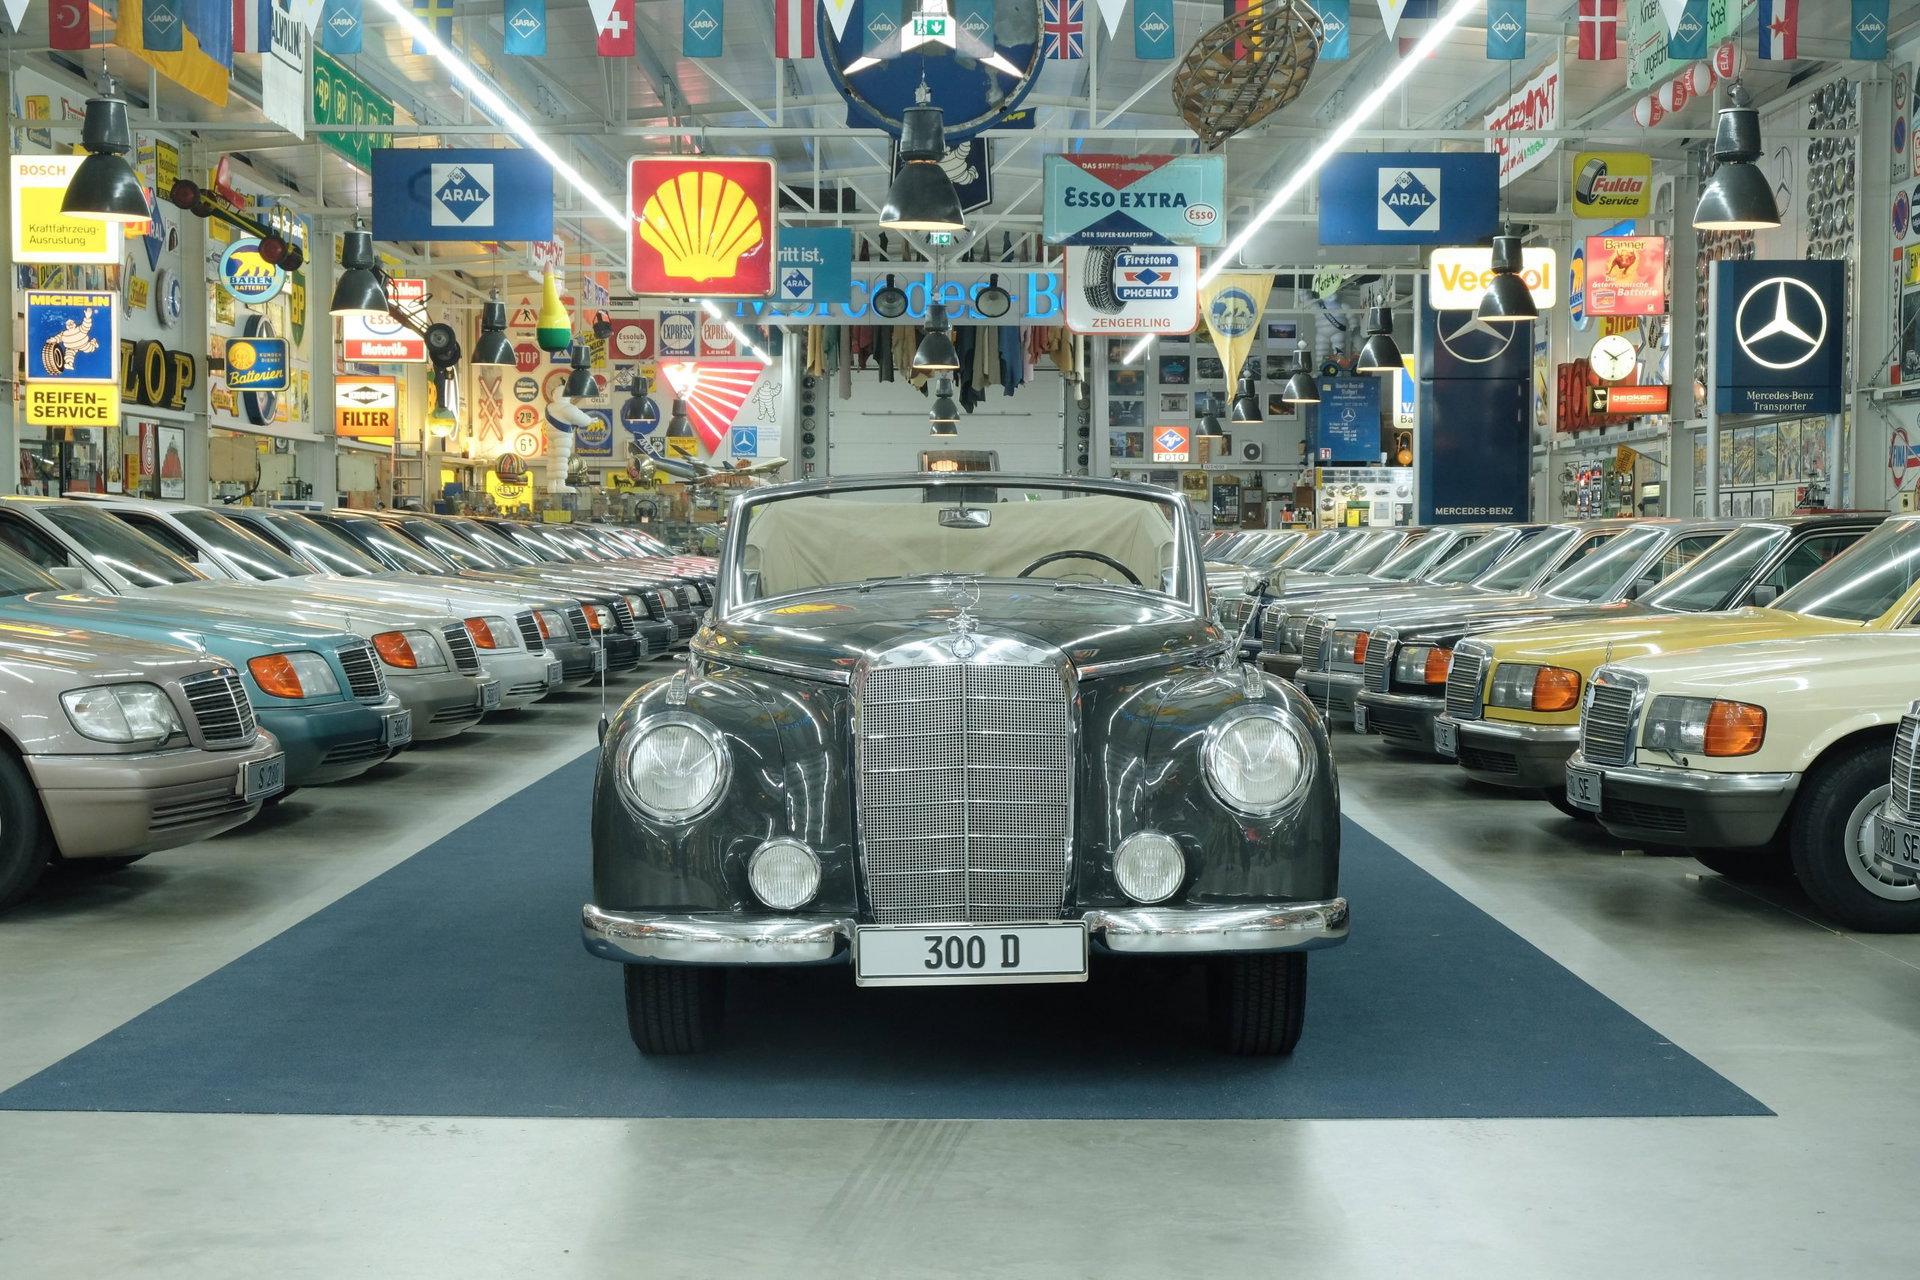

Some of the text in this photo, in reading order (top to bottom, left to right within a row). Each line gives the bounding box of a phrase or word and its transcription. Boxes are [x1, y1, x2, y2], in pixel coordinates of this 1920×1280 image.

[19, 165, 66, 176] BOSCH
[1594, 178, 1643, 193] Fulda
[442, 188, 484, 202] ARAL
[1120, 192, 1188, 208] EXTRA
[1388, 193, 1430, 206] ARAL
[1599, 196, 1639, 205] Service
[29, 224, 100, 235] Kraftfahrzeug-
[1605, 239, 1646, 250] Banner
[801, 249, 824, 264] ist,
[1123, 255, 1172, 266] Firestone
[786, 279, 808, 288] ARAL
[1437, 263, 1550, 292] Veeol
[1123, 288, 1172, 298] PHOENIX
[1617, 288, 1658, 297] Batterie
[30, 294, 110, 307] MICHELIN
[1092, 318, 1171, 328] ZENGERLING
[618, 332, 645, 340] Essolub
[663, 323, 693, 340] EXPRESS
[515, 352, 538, 364] STOP
[229, 368, 284, 387] Batterien
[1747, 391, 1814, 400] Mercedes-Benz
[34, 406, 108, 419] SERVICE
[1754, 402, 1807, 412] Transporter
[342, 411, 389, 427] FILTER
[519, 438, 526, 452] 6
[638, 438, 654, 454] ANA
[1158, 453, 1185, 461] FOTO
[496, 486, 523, 494] HELLA
[1435, 507, 1514, 515] MERCEDES-BENZ
[258, 766, 264, 789] S
[1578, 777, 1591, 801] SE
[1902, 832, 1920, 864] SE
[922, 934, 1020, 968] 300 D
